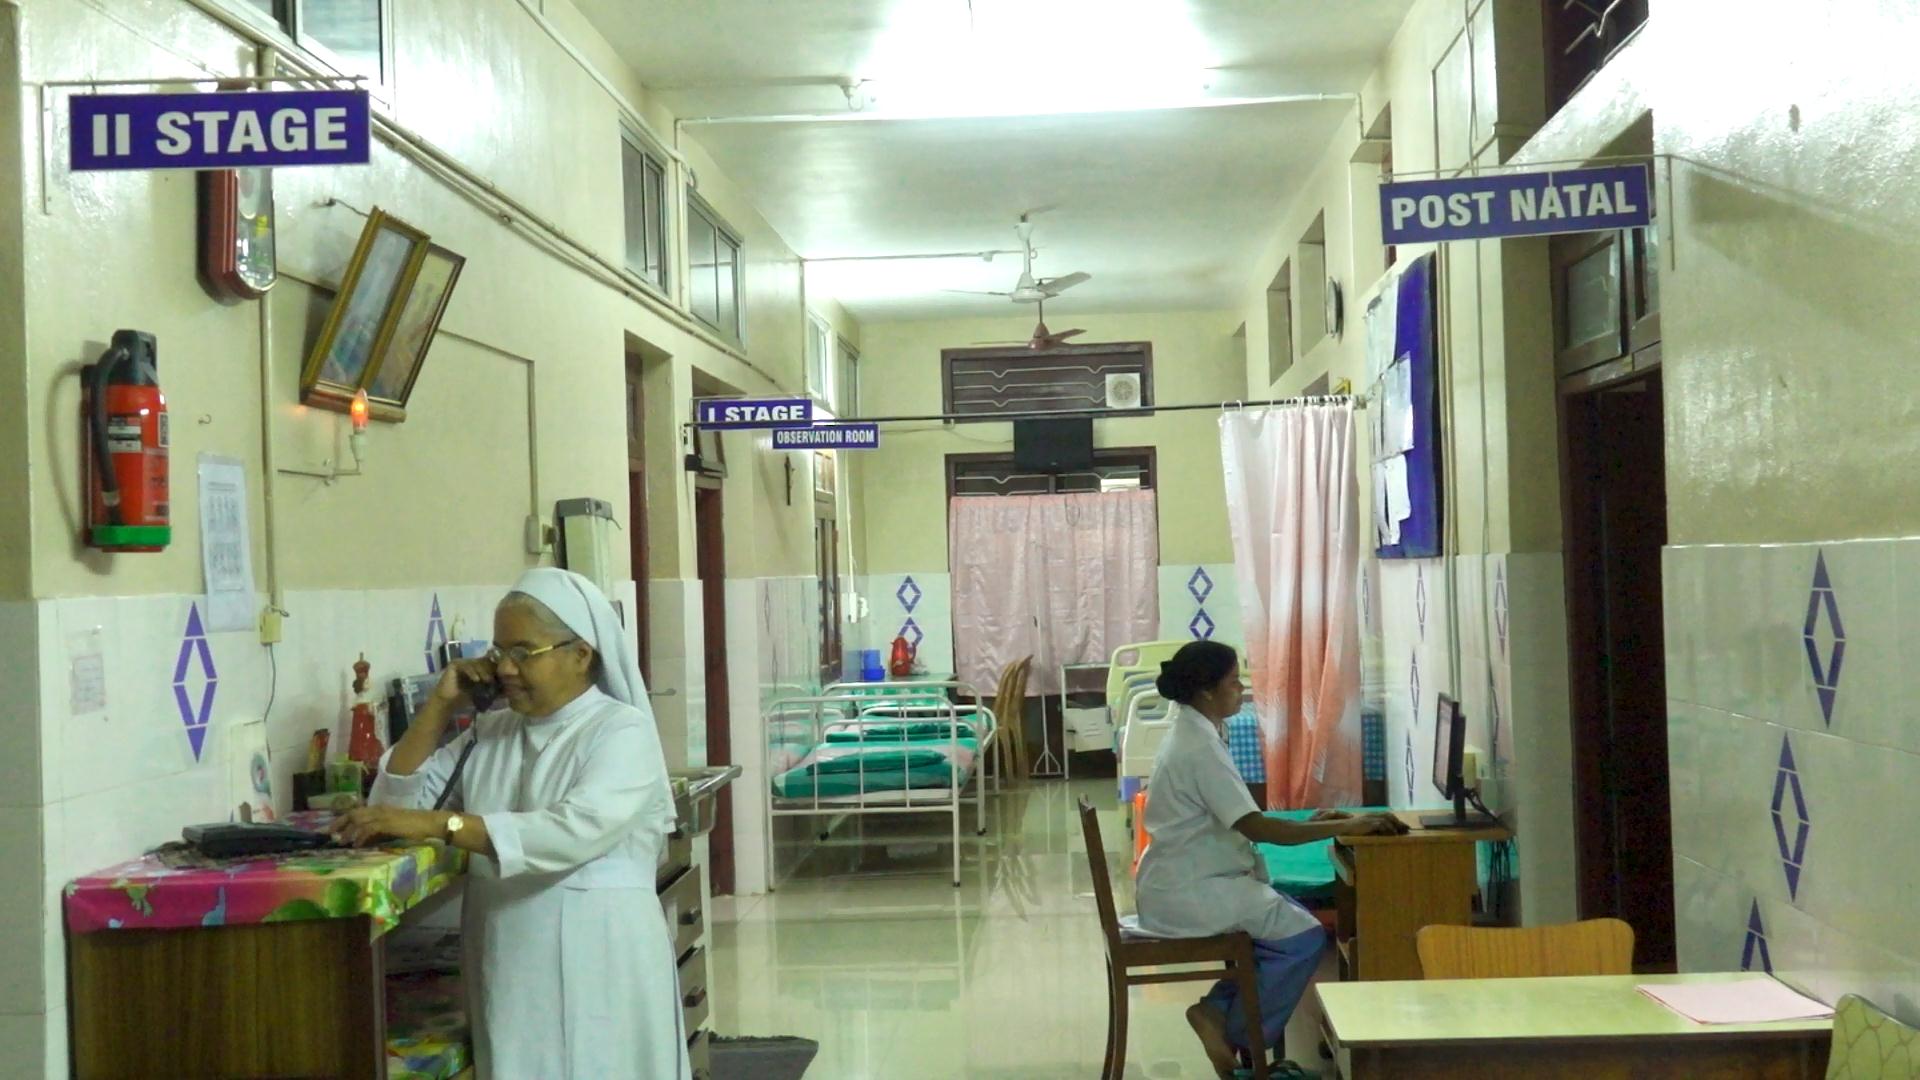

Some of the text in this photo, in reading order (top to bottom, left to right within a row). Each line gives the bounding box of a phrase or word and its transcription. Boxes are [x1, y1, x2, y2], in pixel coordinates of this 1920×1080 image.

[92, 107, 347, 156] II STAGE
[1391, 181, 1638, 230] POST NATAL
[708, 405, 804, 423] I STAGE
[777, 430, 874, 444] OBSERVATION ROOM
